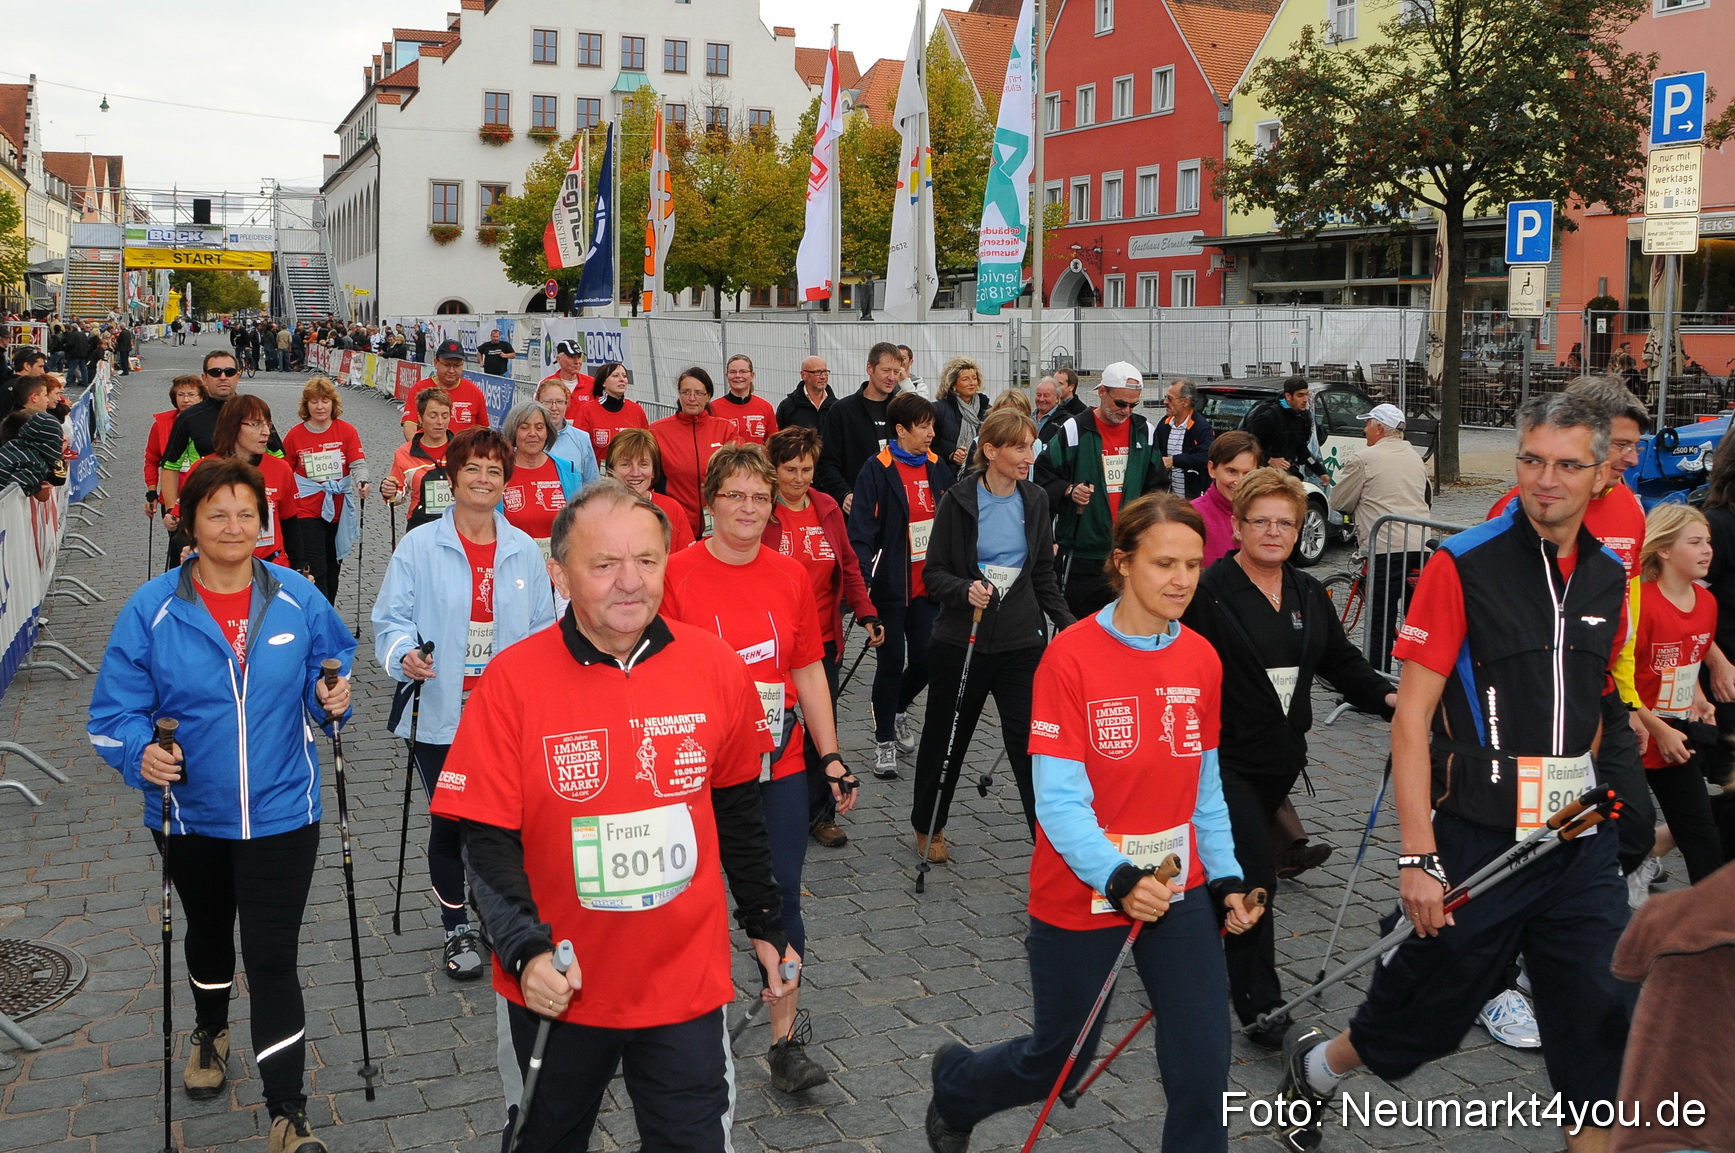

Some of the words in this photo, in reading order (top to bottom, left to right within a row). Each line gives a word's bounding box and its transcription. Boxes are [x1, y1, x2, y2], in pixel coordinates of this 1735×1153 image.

[1662, 83, 1692, 135] P
[1659, 154, 1673, 163] nur
[1676, 152, 1690, 161] mit
[1652, 162, 1697, 173] Parkschein
[1655, 174, 1693, 184] werktags
[1649, 201, 1658, 209] Sa
[148, 229, 204, 242] BOCK
[239, 233, 273, 241] PFLEIDERER
[1516, 209, 1542, 256] P
[1132, 240, 1160, 256] Gasthaus
[1161, 237, 1193, 251] Ehrnsberg
[173, 253, 224, 265] START
[586, 332, 624, 364] BOCK
[316, 461, 339, 472] 8049
[915, 536, 930, 548] 80
[987, 569, 1008, 582] Sonja
[1155, 687, 1167, 696] 11.
[1096, 706, 1132, 718] IMMER
[629, 718, 644, 729] 11.
[644, 713, 707, 727] NEUMARKTER
[1094, 716, 1135, 728] WIEDER
[643, 723, 697, 737] STADTLAUF
[1097, 726, 1132, 741] NEU
[554, 739, 599, 755] IMMER
[1098, 740, 1134, 750] MARKT
[553, 750, 602, 766] WIEDER
[557, 762, 599, 781] NEU
[559, 778, 600, 793] MARKT
[606, 822, 651, 841] Franz
[1126, 836, 1184, 856] Christiane
[611, 843, 687, 879] 8010
